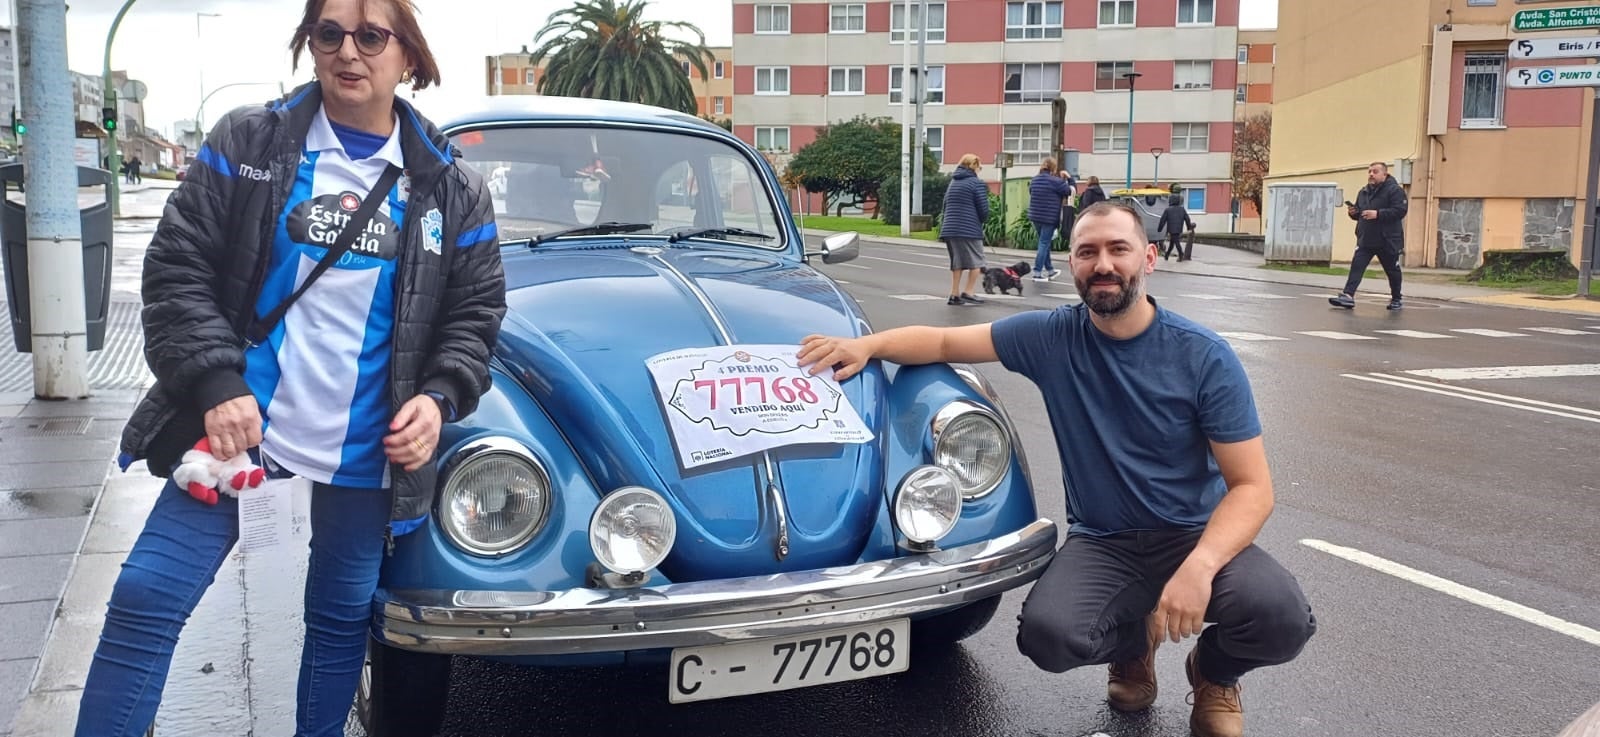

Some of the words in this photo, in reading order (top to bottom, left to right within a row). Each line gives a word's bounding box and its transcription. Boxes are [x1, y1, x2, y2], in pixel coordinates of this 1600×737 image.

[1520, 11, 1546, 20] Avda.
[1549, 10, 1567, 18] San
[1570, 8, 1600, 17] Cristó
[1519, 20, 1545, 28] Avda.
[1548, 17, 1584, 27] Alfonso
[1559, 71, 1592, 80] PUNTO
[307, 204, 386, 236] Estrla
[308, 221, 380, 253] Gacia
[727, 364, 780, 374] PREMIO
[694, 376, 819, 410] 77768
[730, 404, 778, 415] VENDIDO
[780, 402, 806, 413] AQUÍ
[677, 654, 703, 695] C
[772, 628, 895, 684] 77768
